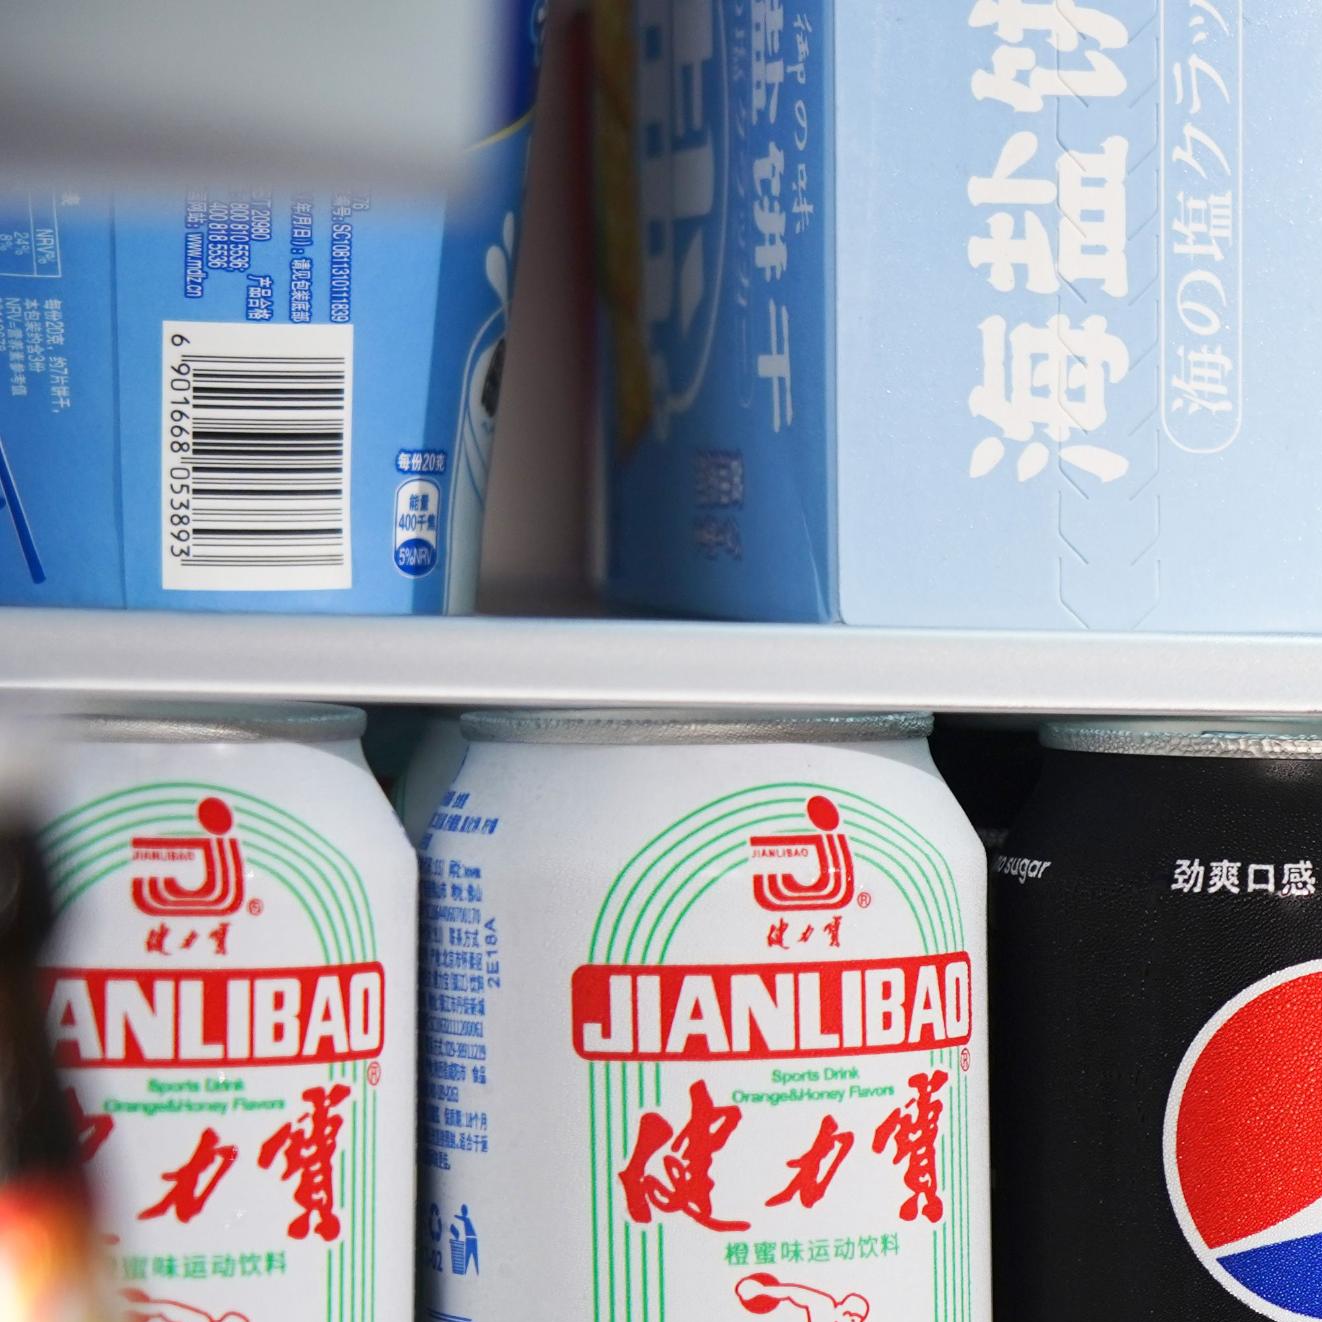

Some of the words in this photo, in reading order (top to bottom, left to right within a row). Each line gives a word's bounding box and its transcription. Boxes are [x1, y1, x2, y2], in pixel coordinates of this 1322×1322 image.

[208, 223, 228, 242] 818
[229, 223, 249, 242] 810
[251, 209, 272, 241] 20980
[14, 231, 30, 256] 24%
[36, 229, 56, 264] NRV%
[967, 0, 1130, 482] 海盐饼
[185, 233, 208, 298] www.mdlz.cn
[208, 244, 228, 269] 5536
[247, 274, 273, 320] 产品合格
[171, 334, 191, 347] 6
[170, 363, 191, 453] 901668
[397, 452, 446, 472] 每份20克
[170, 467, 191, 557] 053893
[409, 494, 429, 511] 能量
[399, 547, 432, 566] 5%NRV
[751, 848, 809, 859] JIANLIBAO
[1004, 857, 1052, 884] sugar
[1170, 859, 1317, 896] 劲爽口感
[484, 917, 501, 988] 2E18A
[49, 971, 381, 1060] ANLIBAO
[583, 961, 970, 1053] JIANLIBAO
[147, 1079, 200, 1095] Sports
[204, 1078, 246, 1092] Drink
[771, 1068, 819, 1085] Sports
[824, 1065, 859, 1080] Drink
[732, 1084, 846, 1107] Orange&Honey
[849, 1082, 895, 1098] Flavors
[722, 1233, 901, 1267] 橙蜜味运动饮料
[110, 1251, 288, 1280] 蜜味运动饮料
